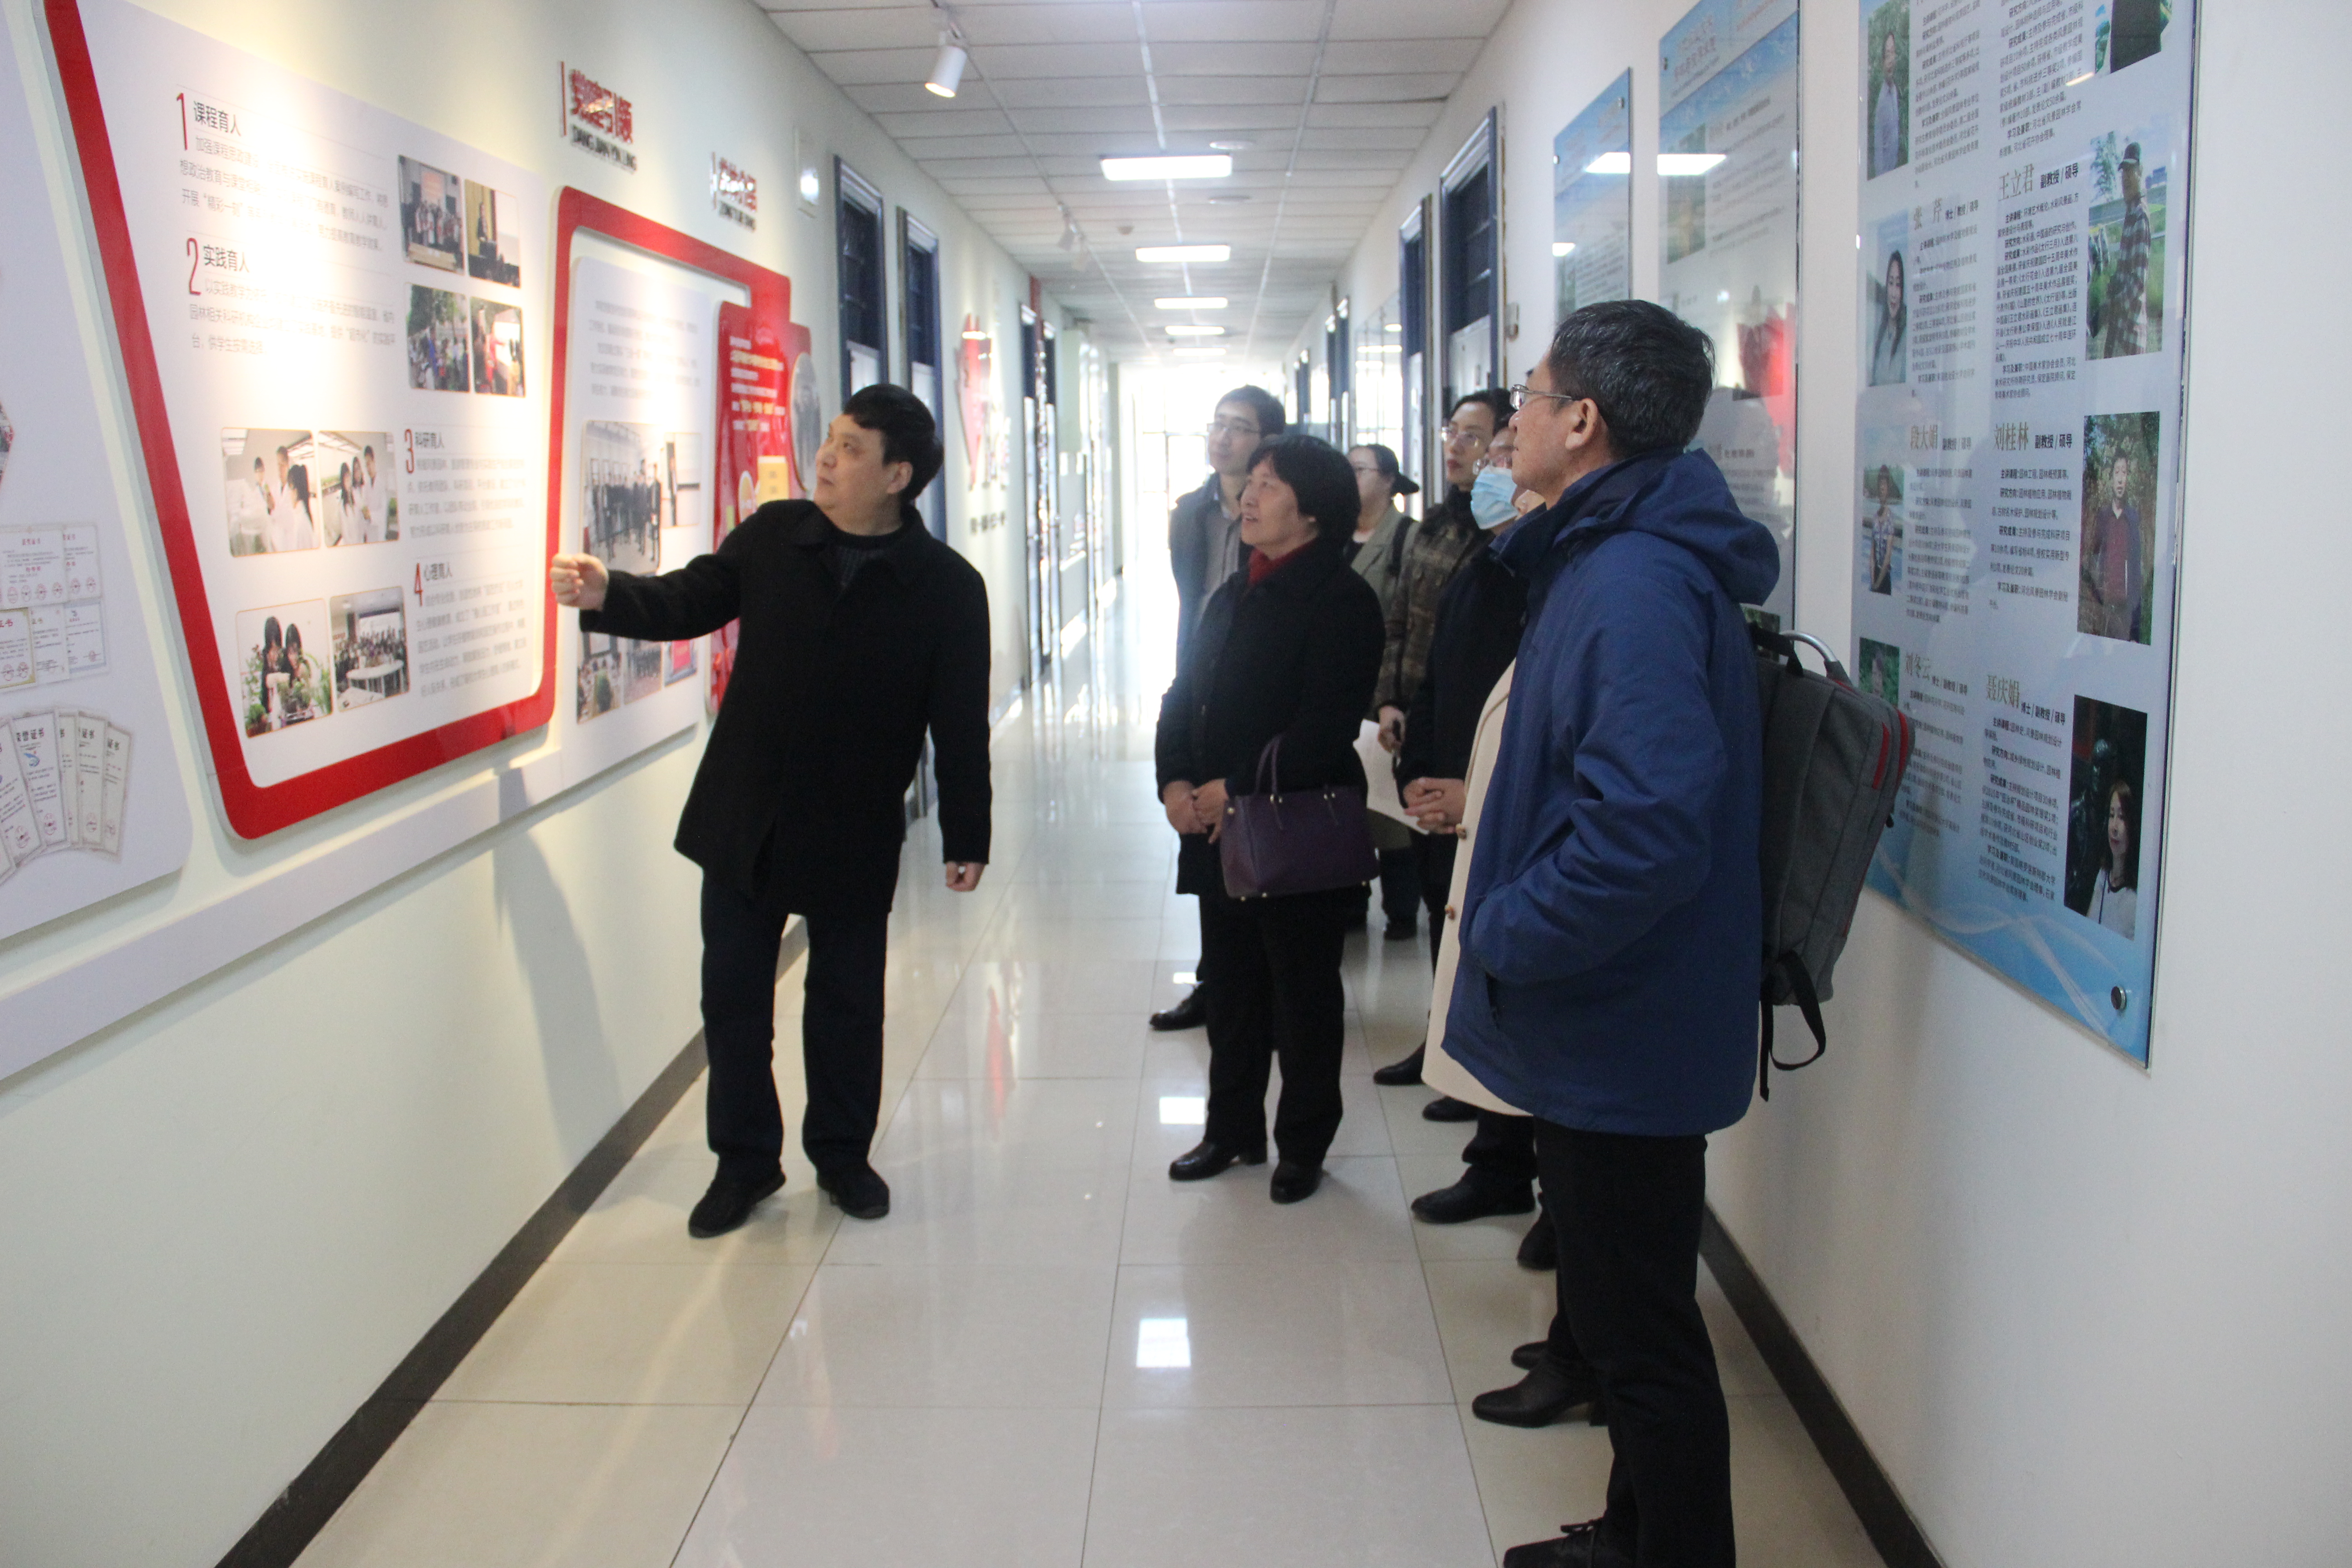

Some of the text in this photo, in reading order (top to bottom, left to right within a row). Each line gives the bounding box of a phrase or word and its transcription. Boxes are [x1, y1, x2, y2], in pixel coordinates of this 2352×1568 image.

[176, 93, 241, 150] 1 课程育人
[569, 69, 632, 144] 党建引领
[1998, 162, 2034, 201] 王立君
[187, 237, 249, 295] 2 实践育人
[405, 429, 445, 474] 3 科研育人
[1910, 425, 1937, 450] 段大娟
[1993, 421, 2029, 450] 刘桂林
[415, 562, 452, 606] 4 心理育人
[1905, 652, 1931, 680] 刘冬云
[1986, 674, 2020, 709] 聂庆娟
